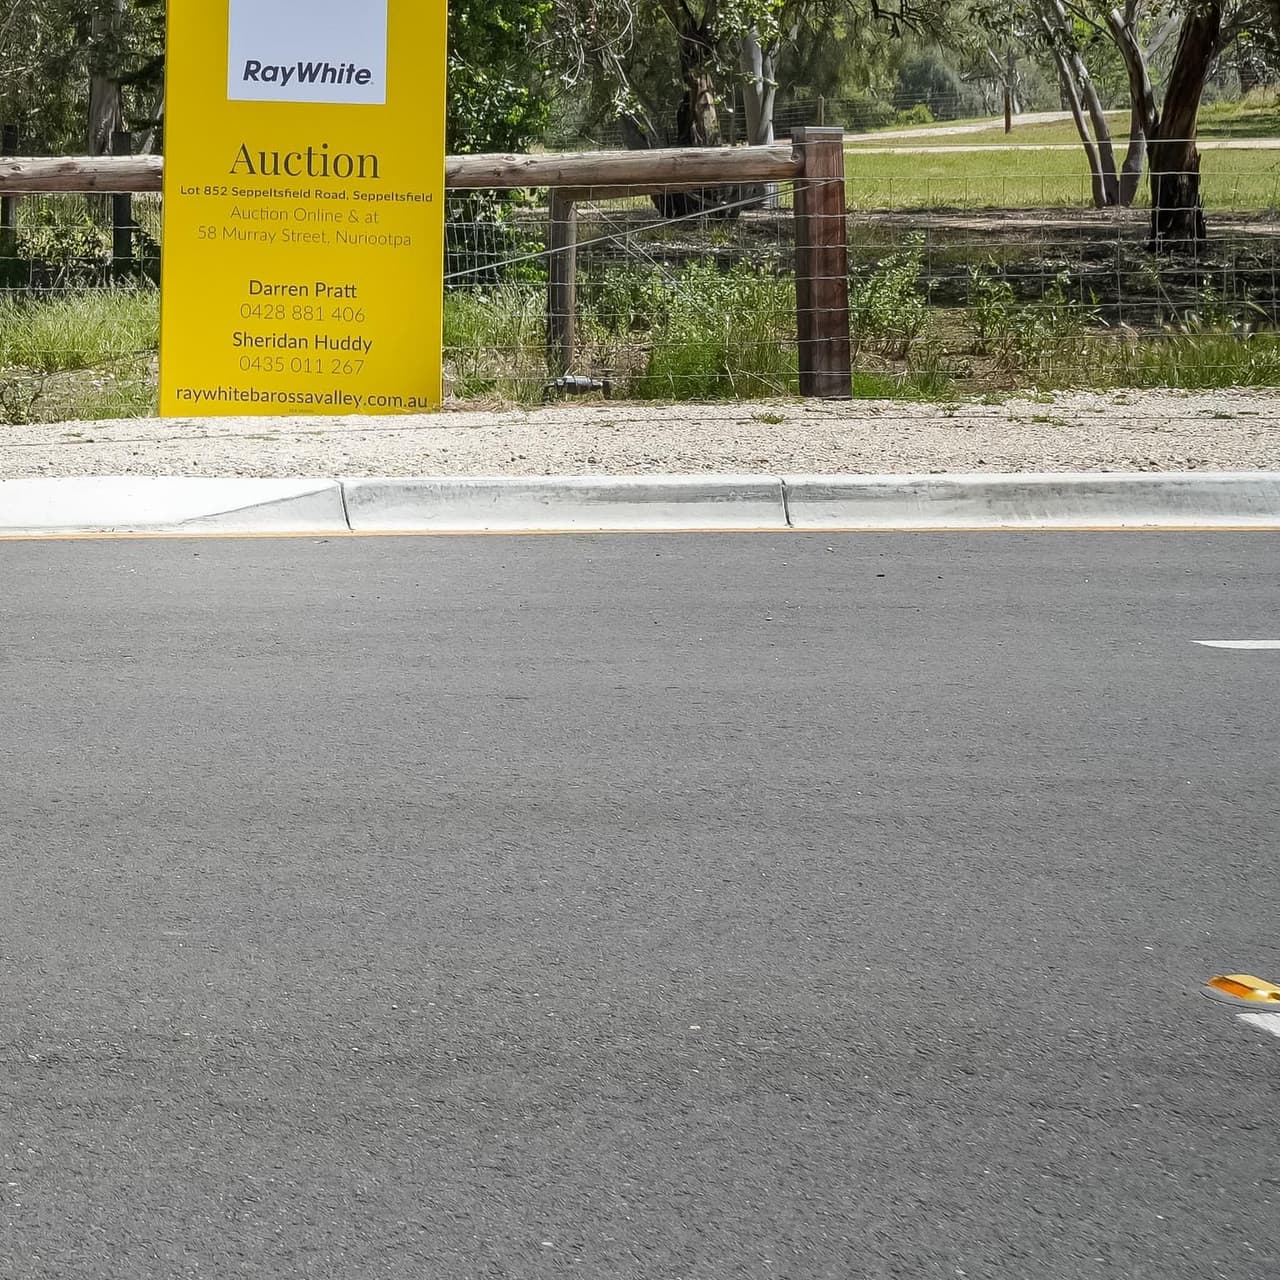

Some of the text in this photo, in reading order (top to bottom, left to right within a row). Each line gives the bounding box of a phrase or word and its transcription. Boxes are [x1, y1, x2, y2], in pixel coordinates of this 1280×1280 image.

[229, 143, 380, 179] Auction
[180, 185, 200, 195] Lot
[204, 186, 228, 196] 852
[231, 186, 311, 199] Seppeltsfield
[353, 190, 433, 203] Seppeltsfield
[230, 206, 379, 224] Auction Online & at
[198, 226, 411, 248] 58 Murray Street, Nuriootpa
[249, 280, 357, 298] Darren Pratt
[240, 303, 365, 323] 0428 881 406
[232, 331, 372, 355] Sheridan Huddy
[239, 356, 364, 376] 0435 011 267
[176, 386, 428, 408] raywhitebarossavalley.com.au
